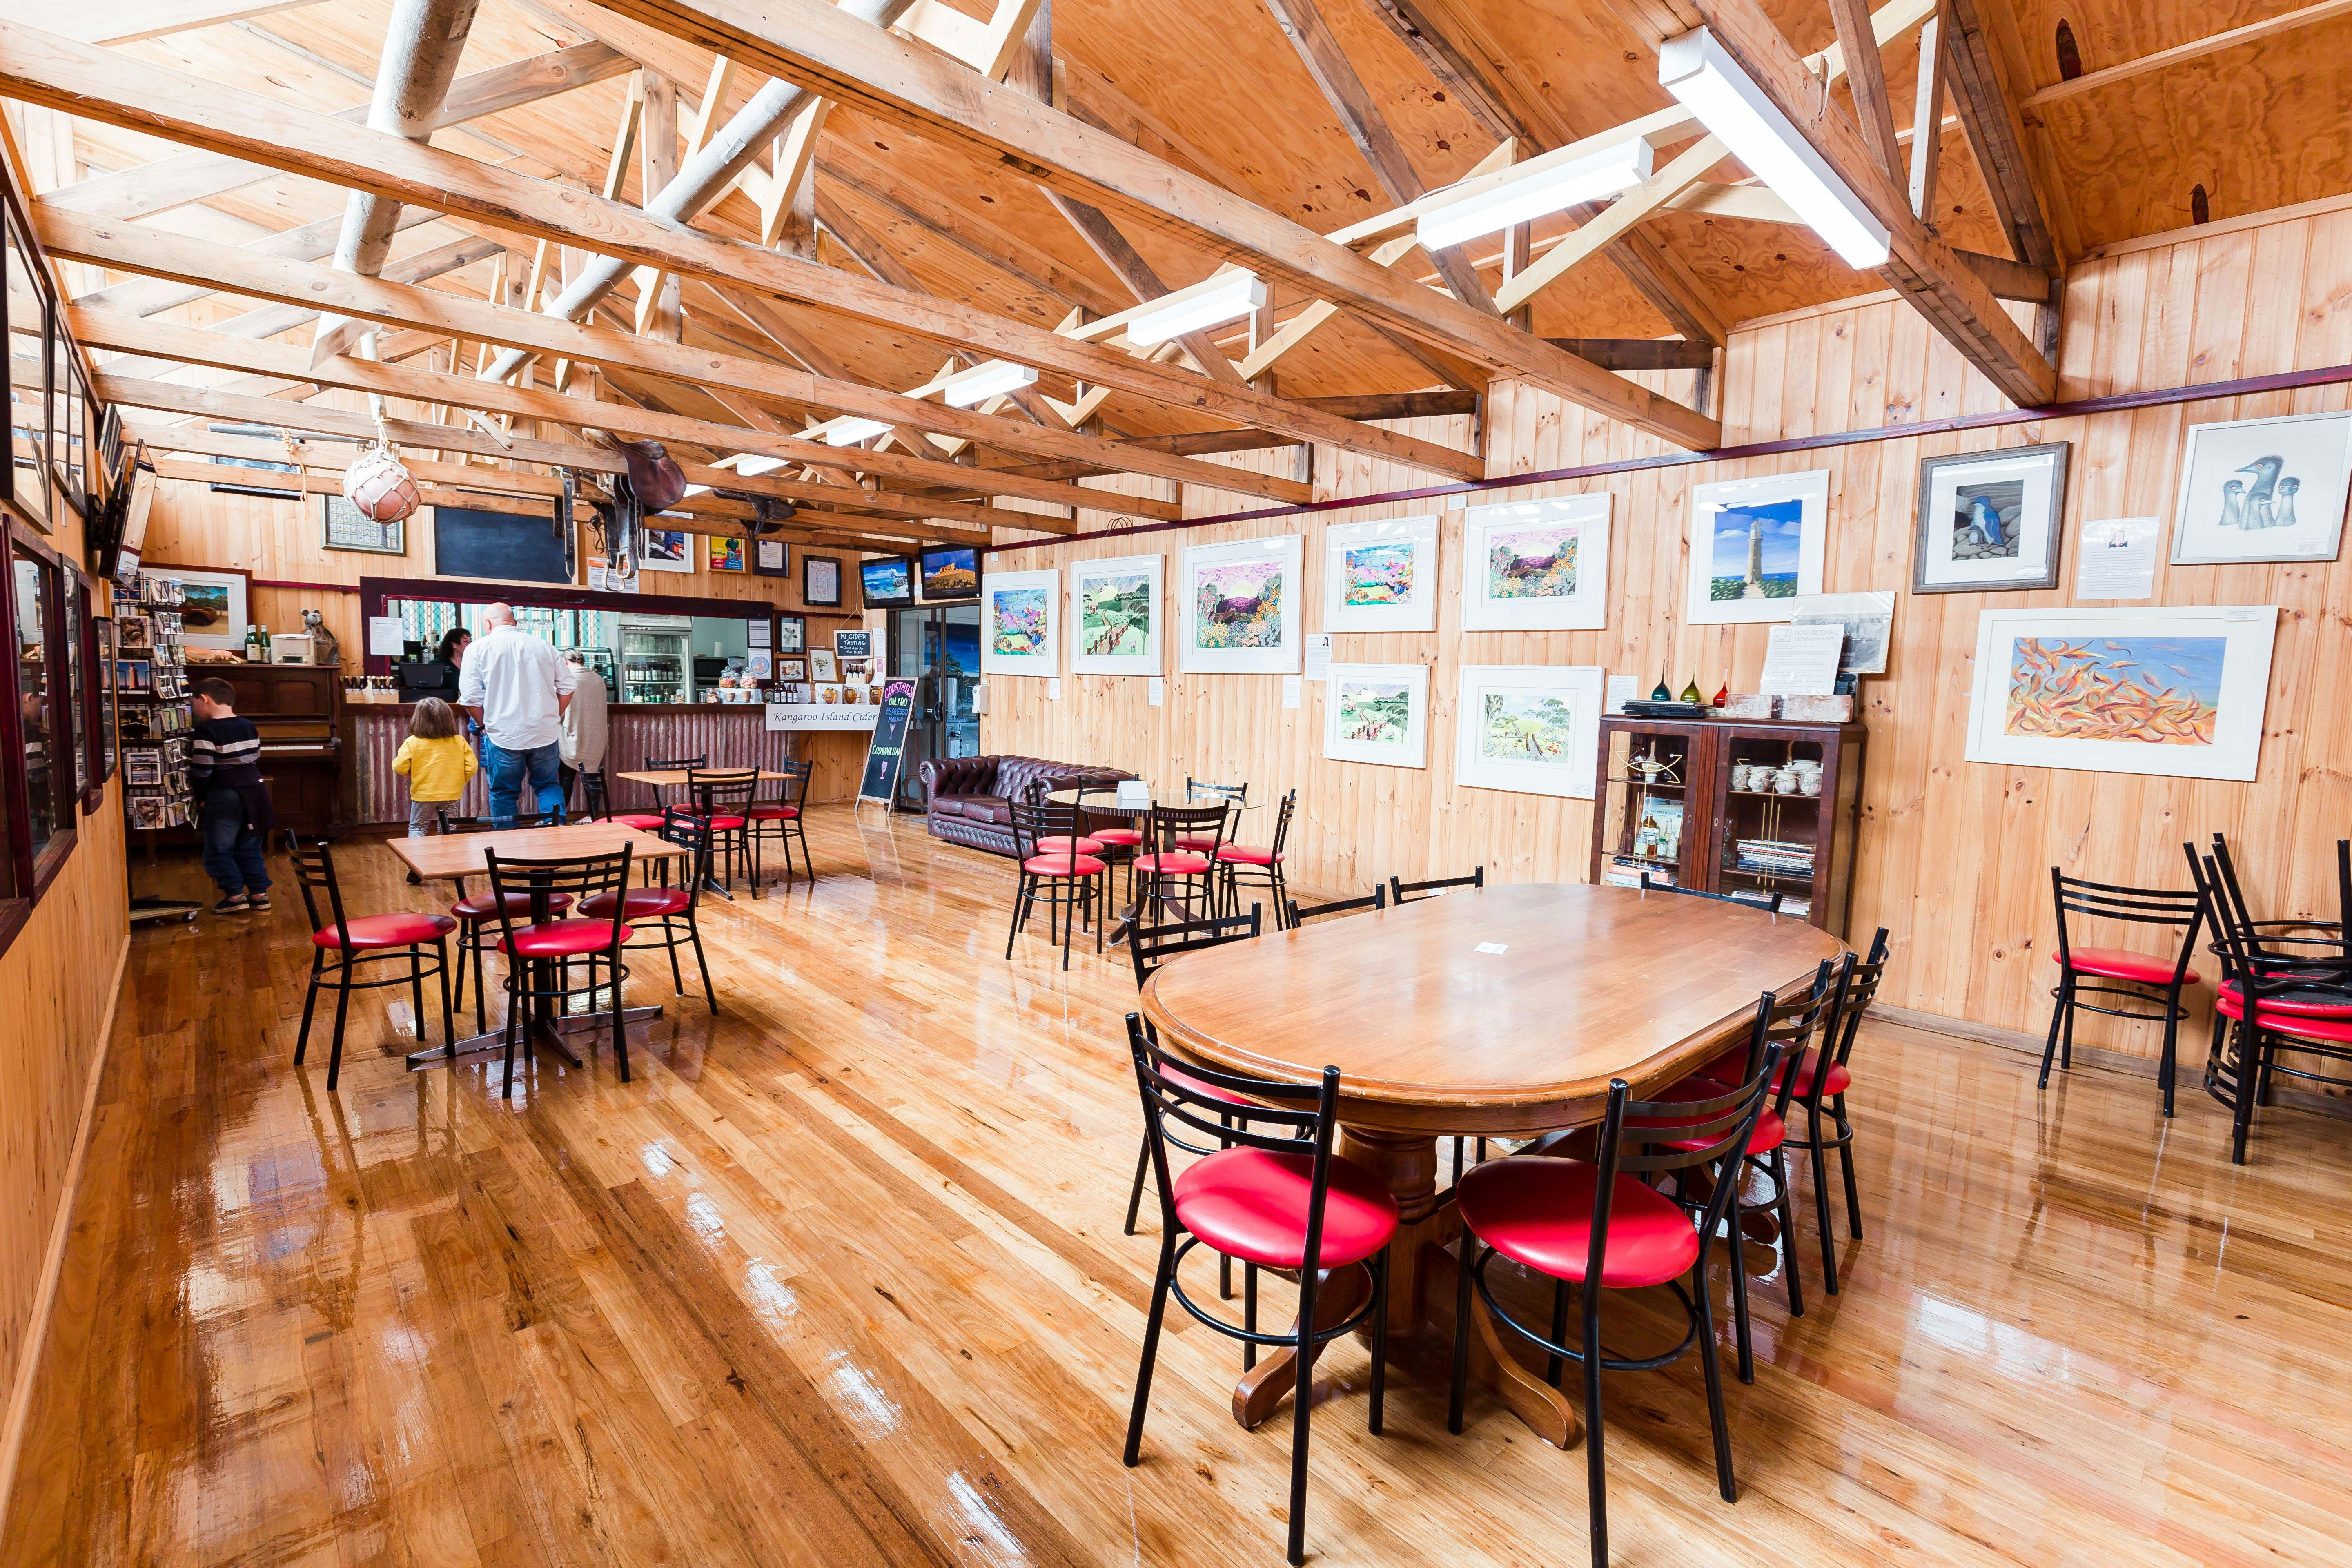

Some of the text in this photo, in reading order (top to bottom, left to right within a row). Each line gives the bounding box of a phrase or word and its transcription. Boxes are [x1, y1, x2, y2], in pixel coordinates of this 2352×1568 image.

[884, 682, 914, 699] COCKTAILS
[889, 697, 900, 706] ONLY
[886, 707, 909, 715] ESPRESSO
[773, 711, 877, 724] Kangaroo Island Cider
[872, 744, 901, 756] COSMOPOLITAN
